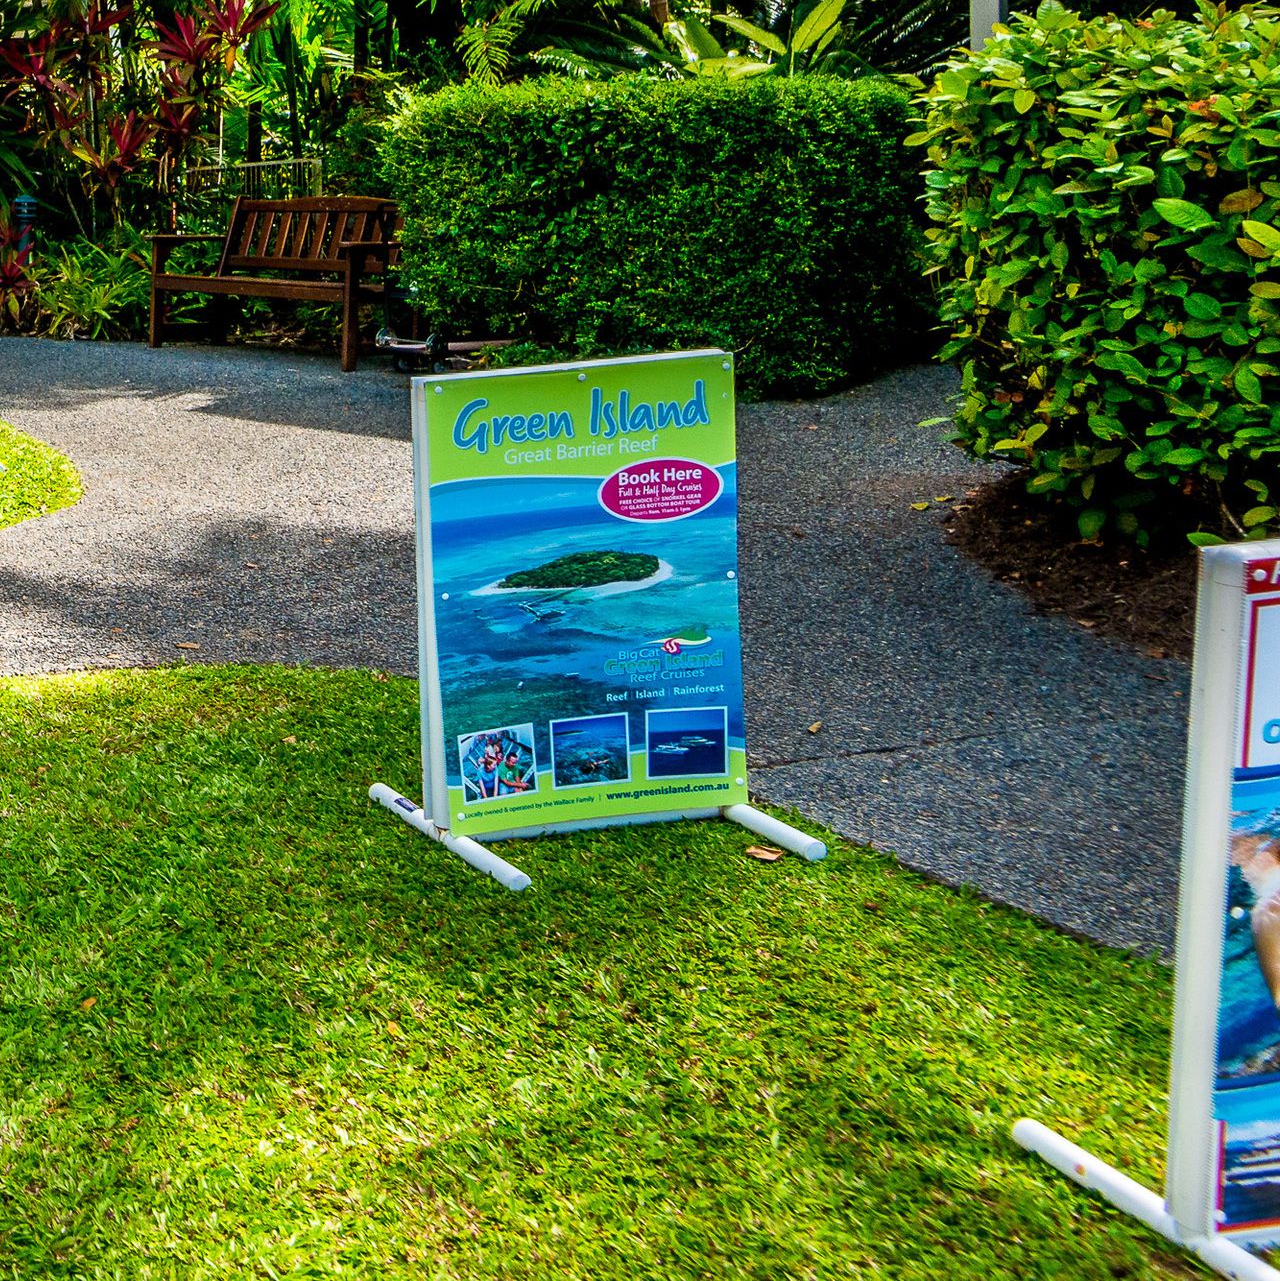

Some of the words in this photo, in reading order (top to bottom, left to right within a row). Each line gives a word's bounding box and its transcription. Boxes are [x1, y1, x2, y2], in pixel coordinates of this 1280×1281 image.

[452, 398, 575, 454] Green
[589, 379, 709, 439] Island
[504, 445, 551, 465] Great
[556, 439, 613, 461] Barrier
[618, 434, 659, 453] Reef
[618, 469, 660, 486] Book
[663, 467, 702, 482] Here
[618, 487, 632, 497] Full
[643, 485, 659, 497] Half
[661, 484, 676, 495] Day
[677, 482, 702, 492] Cruises
[604, 658, 661, 676] Green
[664, 649, 724, 671] Island
[618, 651, 638, 661] Big
[639, 648, 660, 658] Cat
[630, 672, 657, 682] Reef
[661, 669, 705, 680] Cruises
[606, 692, 628, 702] Reef
[636, 688, 665, 699] Island
[673, 684, 725, 696] Rainforest
[464, 811, 483, 819] Locally
[484, 808, 503, 816] owned
[509, 804, 534, 813] operated
[553, 798, 575, 807] Wallace
[575, 796, 594, 804] Family
[606, 783, 730, 800] www.greenisland.com.au
